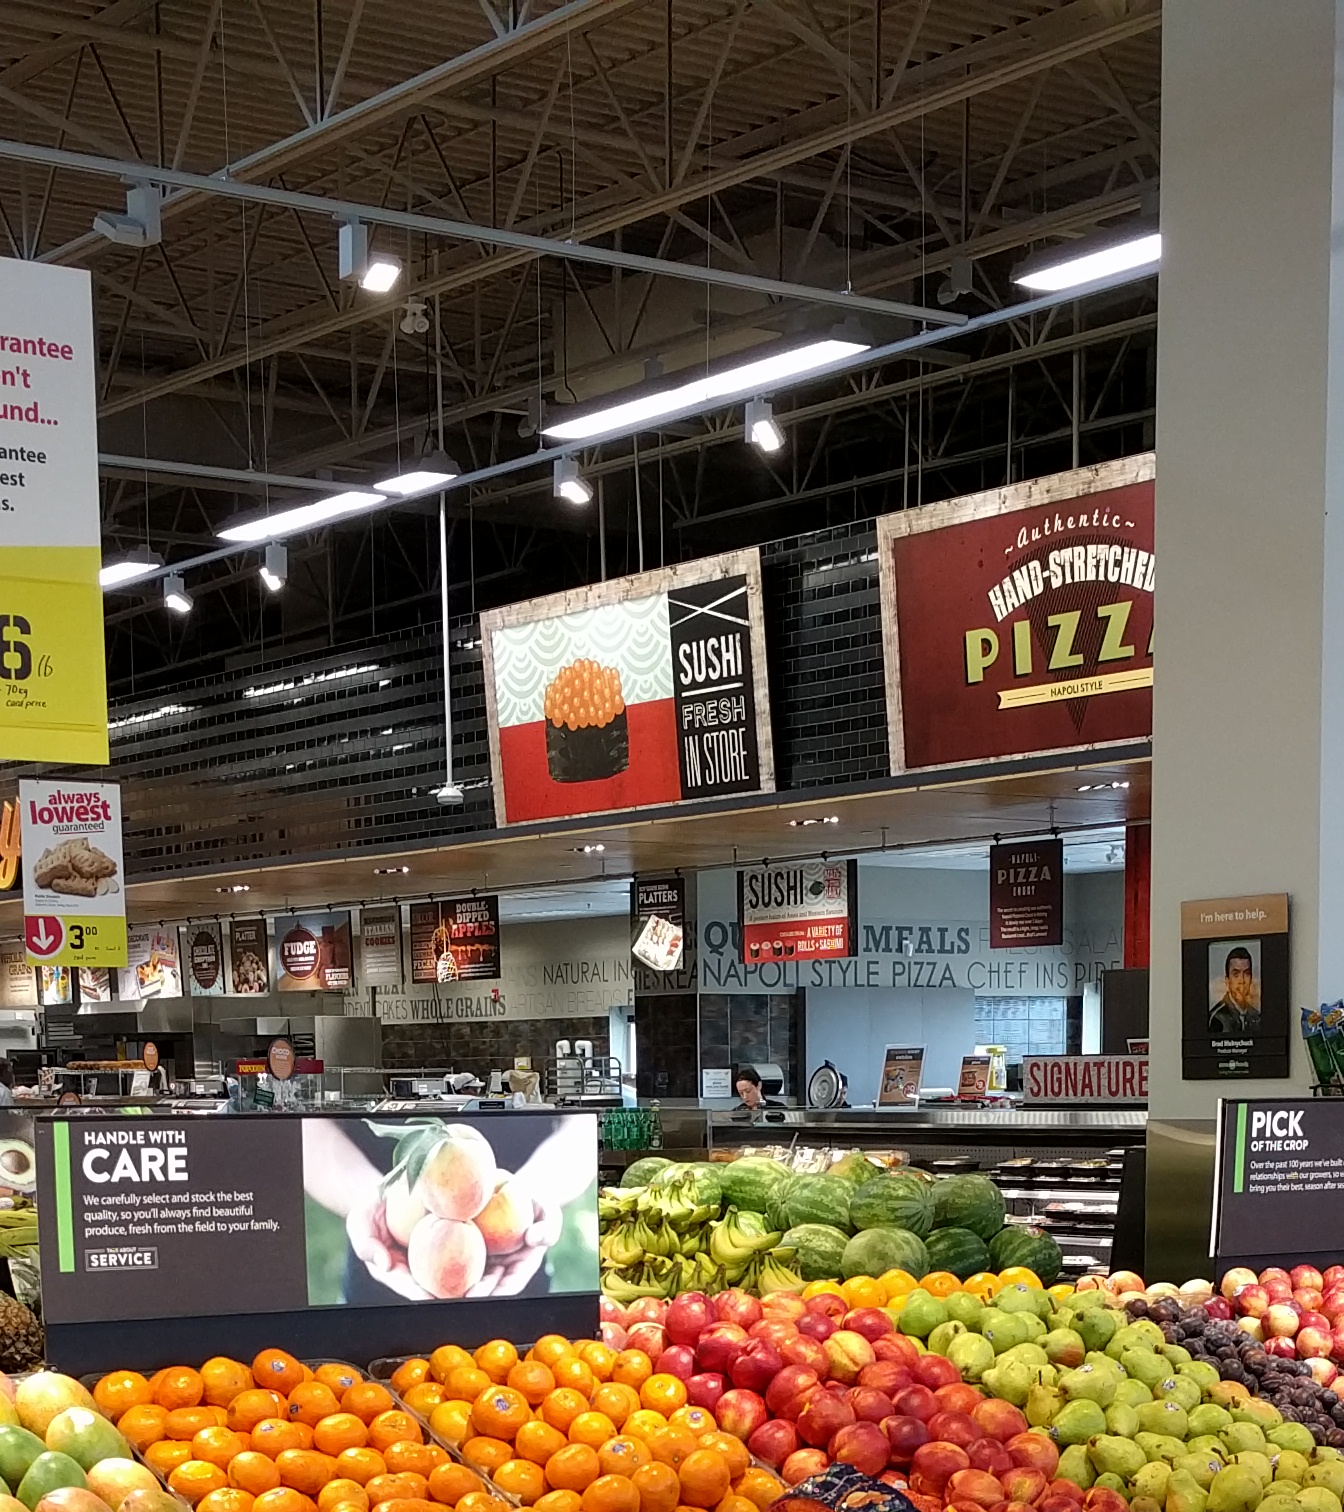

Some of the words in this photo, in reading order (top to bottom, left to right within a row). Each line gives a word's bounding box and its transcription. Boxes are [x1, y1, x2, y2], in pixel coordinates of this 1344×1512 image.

[1017, 507, 1122, 547] Authentic
[964, 600, 1154, 686] PIZZ
[678, 632, 743, 685] SUSHI
[681, 696, 746, 730] FRESH
[684, 734, 702, 788] IN
[703, 728, 750, 785] STORE
[48, 790, 100, 808] always
[29, 799, 112, 825] lowest
[52, 820, 105, 834] guaranteed
[997, 865, 1052, 884] PIZZA
[748, 869, 803, 909] SUSHI
[1214, 911, 1234, 922] here
[451, 920, 495, 938] APPLES
[862, 924, 970, 954] MEALS
[284, 940, 316, 955] FUDGE
[892, 960, 956, 988] PIZZA
[967, 961, 1029, 989] CHEF
[410, 998, 453, 1020] WHOLE
[1029, 1059, 1148, 1098] SIGNATURE
[1251, 1110, 1305, 1138] PICK
[84, 1131, 145, 1145] HANDLE
[148, 1130, 186, 1144] WITH
[1250, 1141, 1265, 1151] OF
[1265, 1140, 1282, 1151] THE
[1283, 1139, 1309, 1151] CROP
[82, 1147, 189, 1183] CARE
[101, 1193, 141, 1207] carefully
[142, 1192, 170, 1204] select
[190, 1191, 215, 1202] stock
[159, 1206, 191, 1219] always
[212, 1205, 253, 1216] beautiful
[90, 1252, 152, 1267] SERVICE
